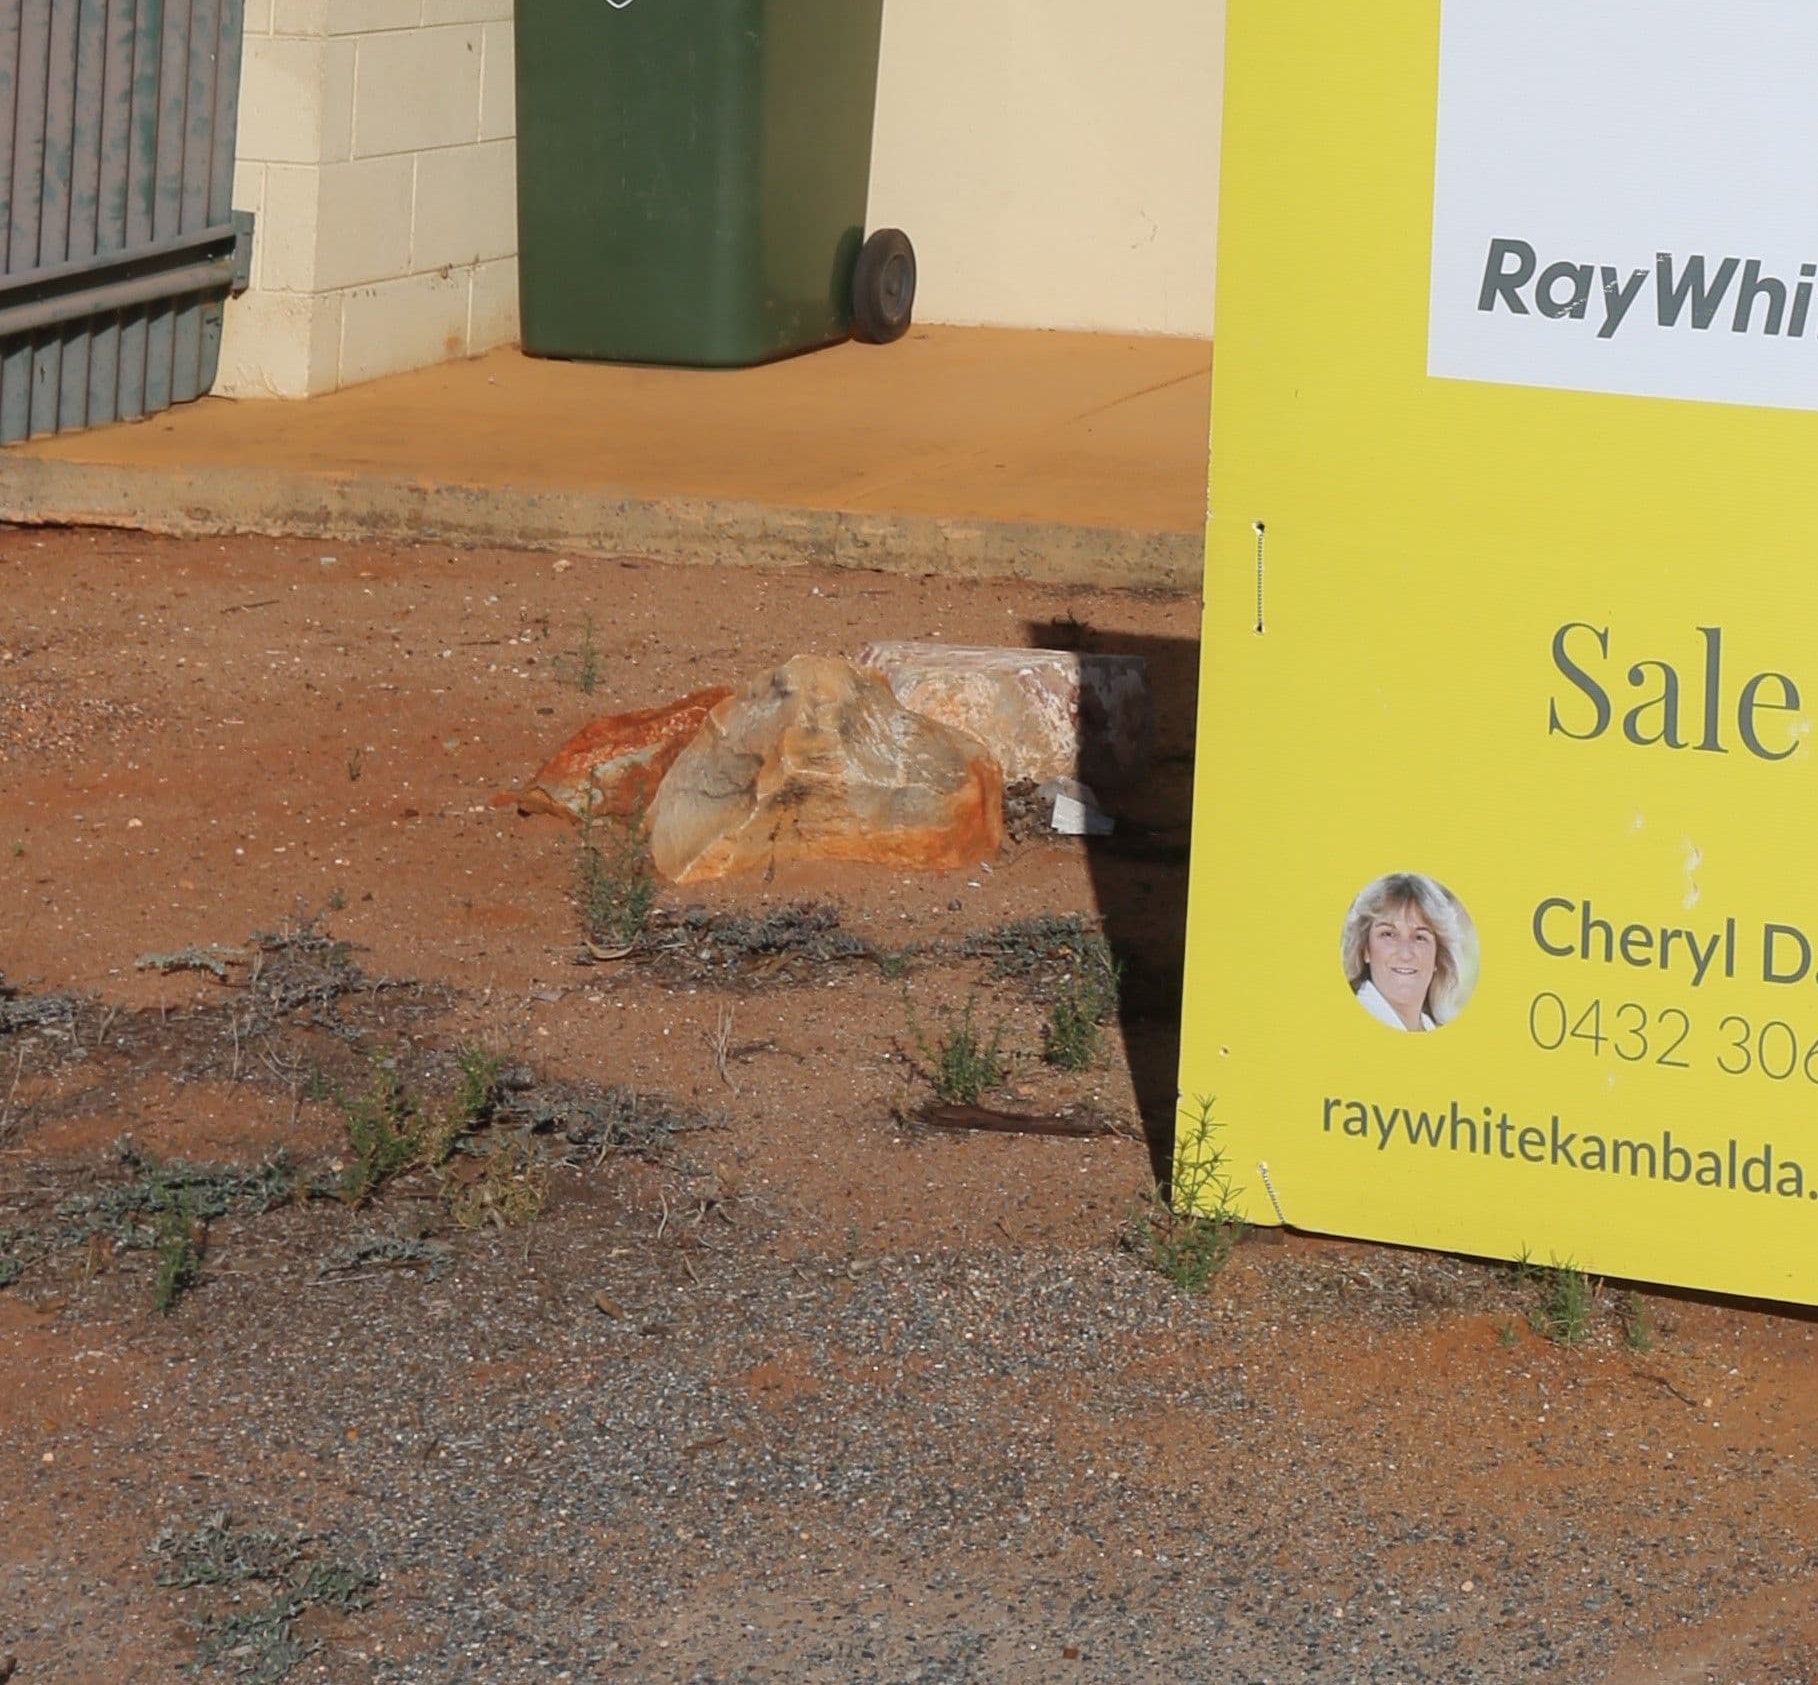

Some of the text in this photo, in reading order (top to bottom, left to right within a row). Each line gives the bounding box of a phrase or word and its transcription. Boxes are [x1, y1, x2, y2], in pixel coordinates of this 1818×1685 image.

[1548, 622, 1801, 761] Sale
[1532, 897, 1736, 987] Cheryl
[1529, 992, 1690, 1069] 0432
